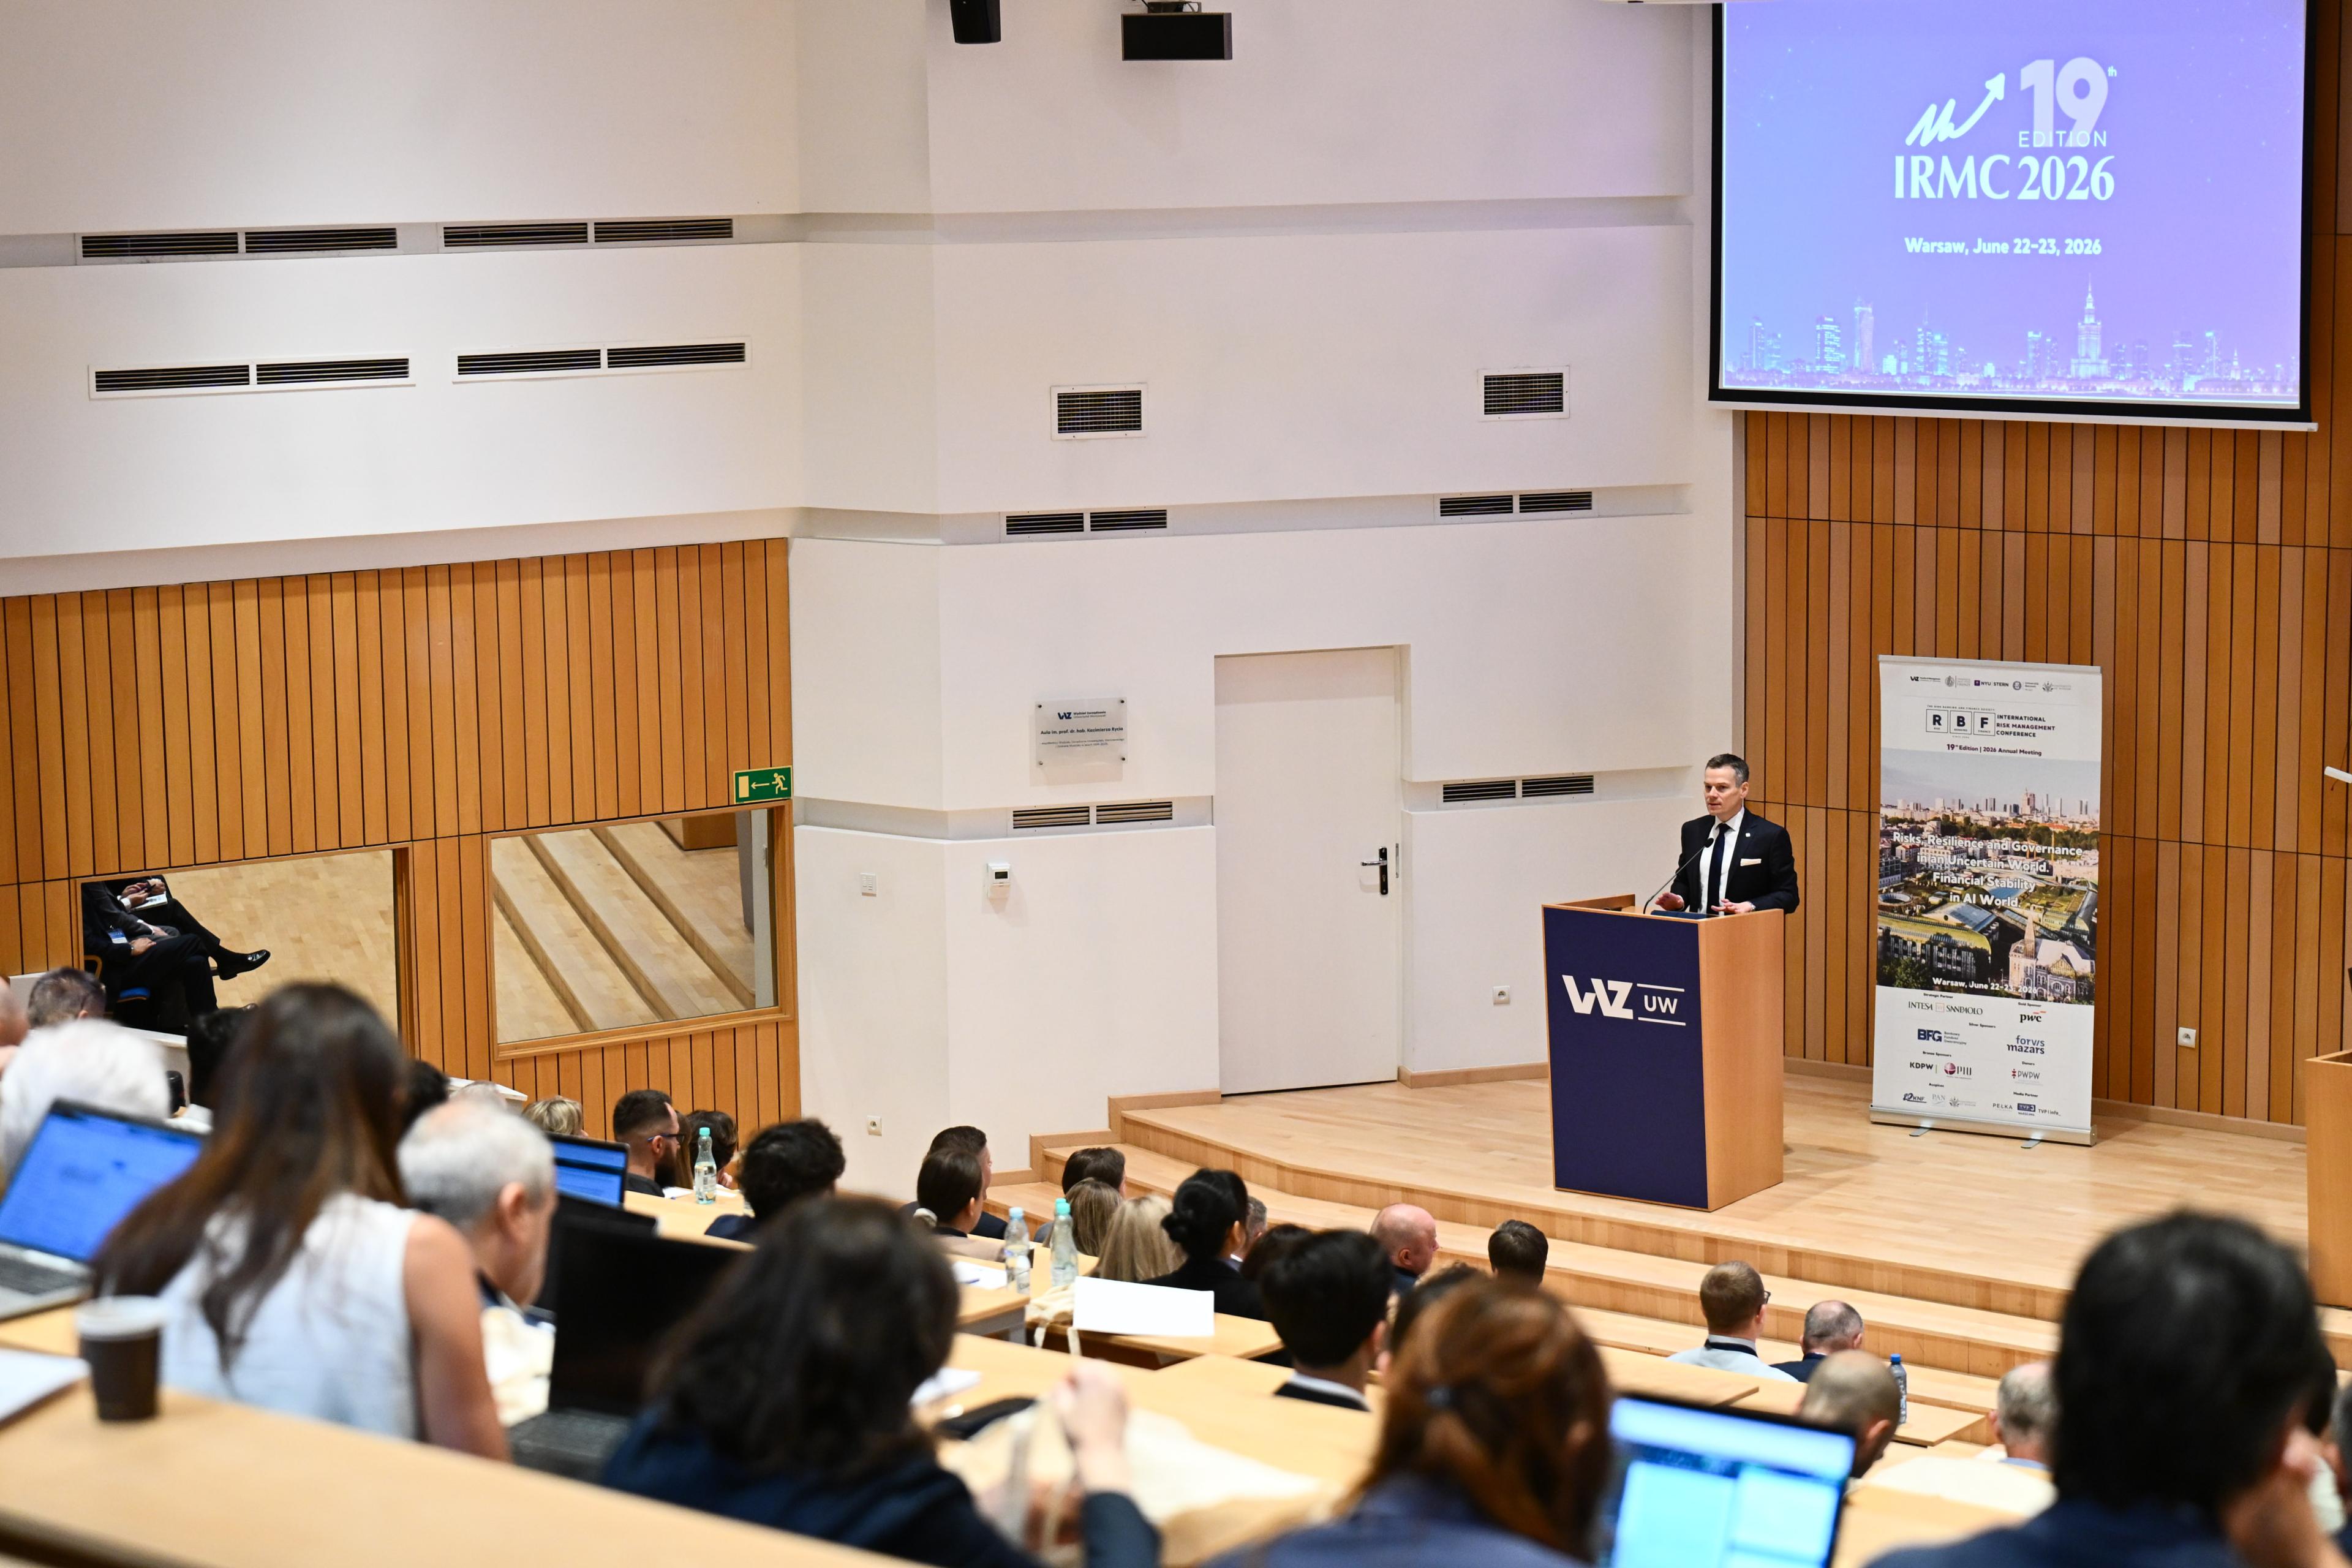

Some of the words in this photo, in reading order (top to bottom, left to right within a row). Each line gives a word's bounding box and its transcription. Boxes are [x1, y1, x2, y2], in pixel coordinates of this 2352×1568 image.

[2019, 130, 2108, 148] EDITION
[1894, 154, 2010, 200] IRMC
[2017, 155, 2115, 201] 2026
[1904, 237, 1969, 256] Warsaw,
[1972, 238, 2009, 255] June
[2064, 238, 2102, 255] 2026
[1932, 714, 1942, 726] R
[1956, 715, 1966, 727] B
[1980, 717, 1989, 729] F
[1893, 831, 1924, 845] Risks,
[1928, 835, 1984, 849] Resilience
[1987, 839, 2008, 851] and
[2011, 840, 2083, 856] Governance
[1917, 852, 1929, 863] in
[1930, 855, 1944, 864] an
[1948, 854, 2005, 869] Uncertain
[2007, 859, 2049, 873] World.
[1933, 872, 1985, 886] Financial
[1986, 876, 2037, 892] Stability
[1950, 891, 1960, 903] in
[1962, 892, 1977, 905] AI
[1980, 894, 2021, 908] World.
[1932, 977, 1967, 988] Warsaw,
[1969, 981, 1988, 990] June
[2018, 985, 2038, 995] 2026
[1644, 994, 1678, 1014] UW
[1908, 1001, 1933, 1011] INTESA
[2019, 1014, 2042, 1023] pwc
[1917, 1028, 1942, 1042] BFG
[2016, 1035, 2045, 1047] forvis
[2007, 1044, 2045, 1055] mazars
[1910, 1061, 1934, 1070] KDPW
[2018, 1070, 2040, 1079] PWPW
